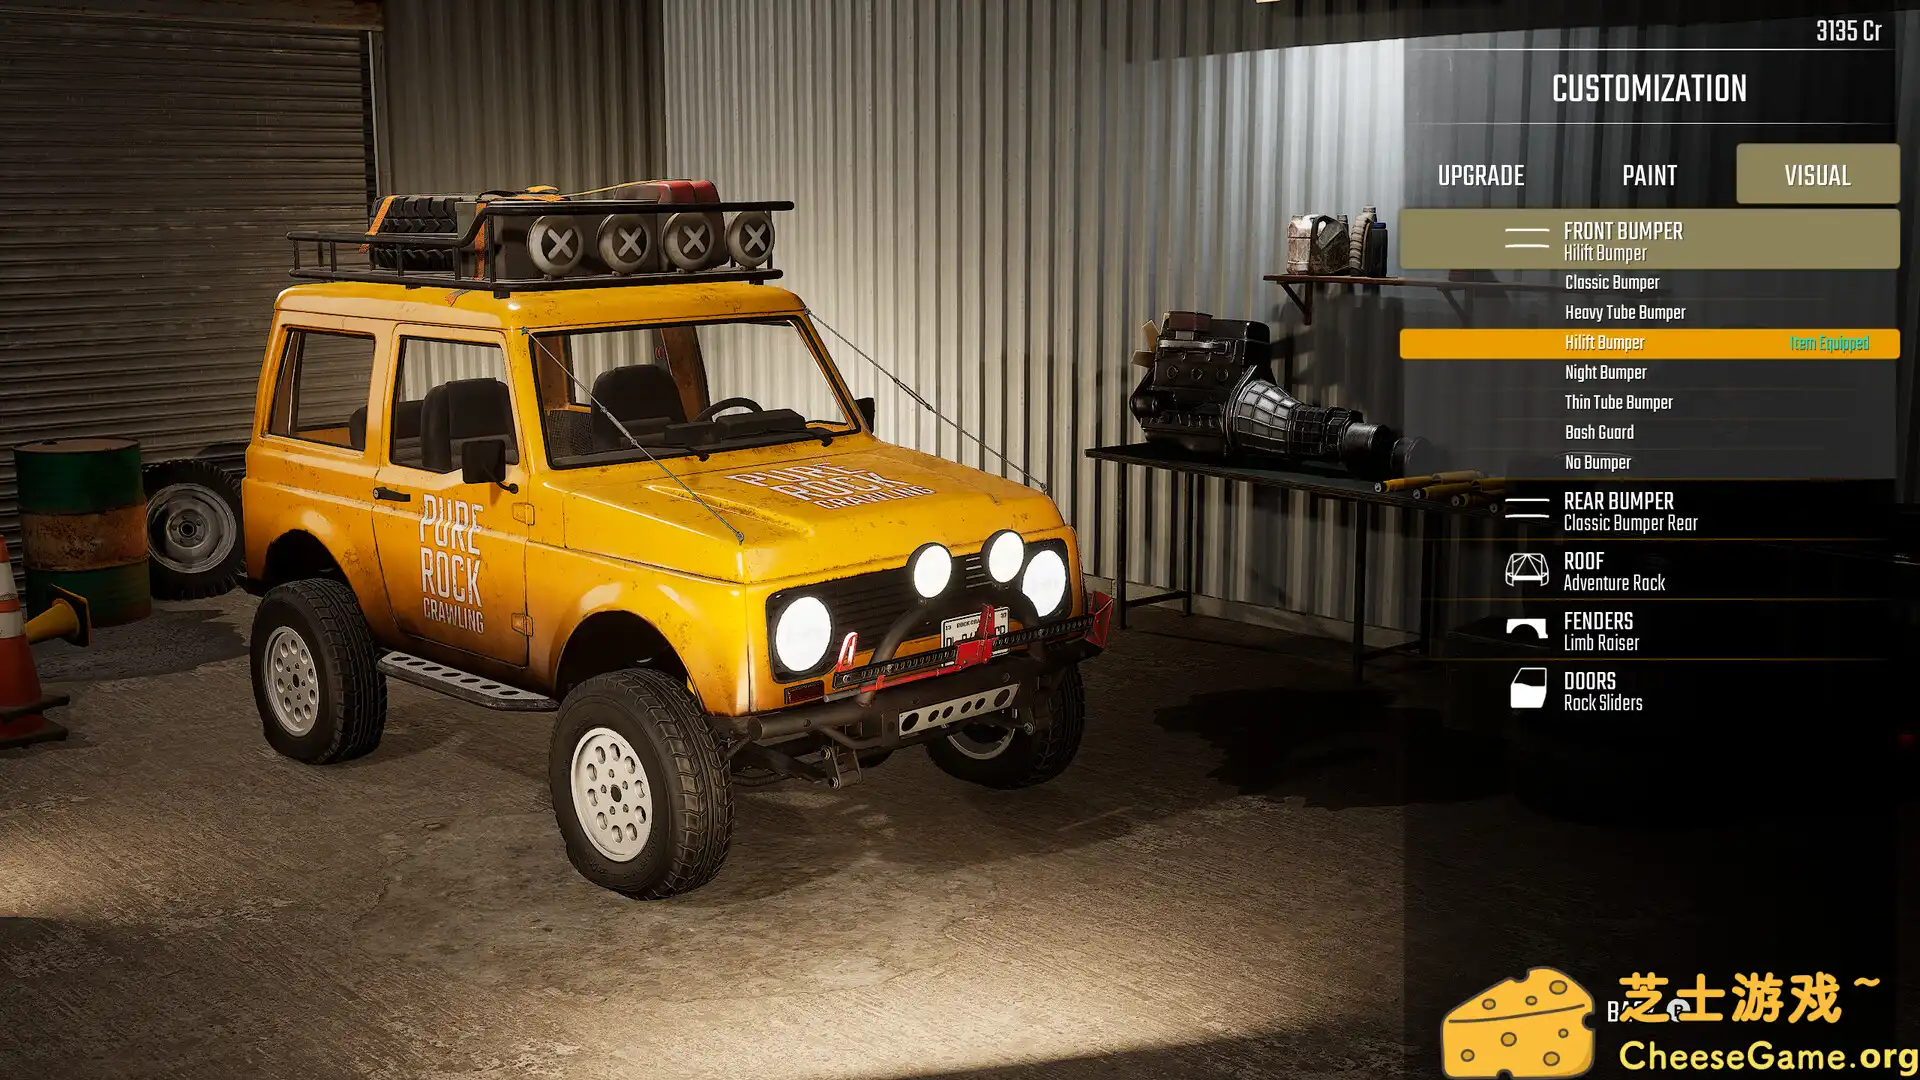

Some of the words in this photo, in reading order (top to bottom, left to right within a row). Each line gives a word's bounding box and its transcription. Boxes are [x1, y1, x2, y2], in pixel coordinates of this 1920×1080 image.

[1816, 19, 1858, 42] 3135
[1863, 19, 1883, 42] Cr
[1552, 73, 1747, 102] CUSTOMIZATION
[1437, 164, 1525, 186] UPGRADE
[1622, 164, 1678, 186] PAINT
[1784, 164, 1852, 187] VISUAL
[1564, 221, 1614, 241] FRONT
[1617, 221, 1684, 241] BUMPER
[1564, 244, 1594, 261] Hilift
[1596, 244, 1648, 264] Bumper
[1565, 274, 1610, 290] Classic
[1612, 275, 1661, 292] Bumper
[1565, 304, 1604, 322] Heavy
[1606, 304, 1636, 320] Tube
[1639, 304, 1687, 322] Bumper
[1565, 334, 1595, 350] Hilift
[1597, 334, 1646, 352] Bumper
[1789, 334, 1817, 351] Item
[1819, 334, 1870, 353] Equipped
[1565, 364, 1598, 382] Night
[1600, 364, 1648, 382] Bumper
[1565, 393, 1591, 410] Thin
[1593, 393, 1623, 410] Tube
[1626, 394, 1674, 412] Bumper
[1565, 423, 1596, 440] Bash
[1598, 423, 1635, 440] Guard
[1565, 454, 1581, 470] No
[1584, 454, 1632, 472] Bumper
[724, 462, 868, 487] PURE
[769, 472, 911, 501] ROCK
[813, 486, 936, 510] CRAWLING
[1564, 491, 1605, 510] REAR
[1608, 491, 1675, 510] BUMPER
[419, 493, 484, 556] PURE
[1564, 514, 1611, 532] Classic
[1613, 514, 1665, 534] Bumper
[1667, 514, 1699, 532] Rear
[1564, 551, 1605, 570] ROOF
[420, 546, 483, 608] ROCK
[1563, 573, 1630, 591] Adventure
[1633, 573, 1666, 591] Rack
[423, 597, 484, 634] CRAWLING
[1564, 611, 1634, 630] FENDERS
[1564, 633, 1595, 651] Limb
[1598, 633, 1640, 651] Raiser
[1564, 671, 1617, 690] DOORS
[1564, 693, 1597, 711] Rock
[1599, 693, 1643, 711] Sliders
